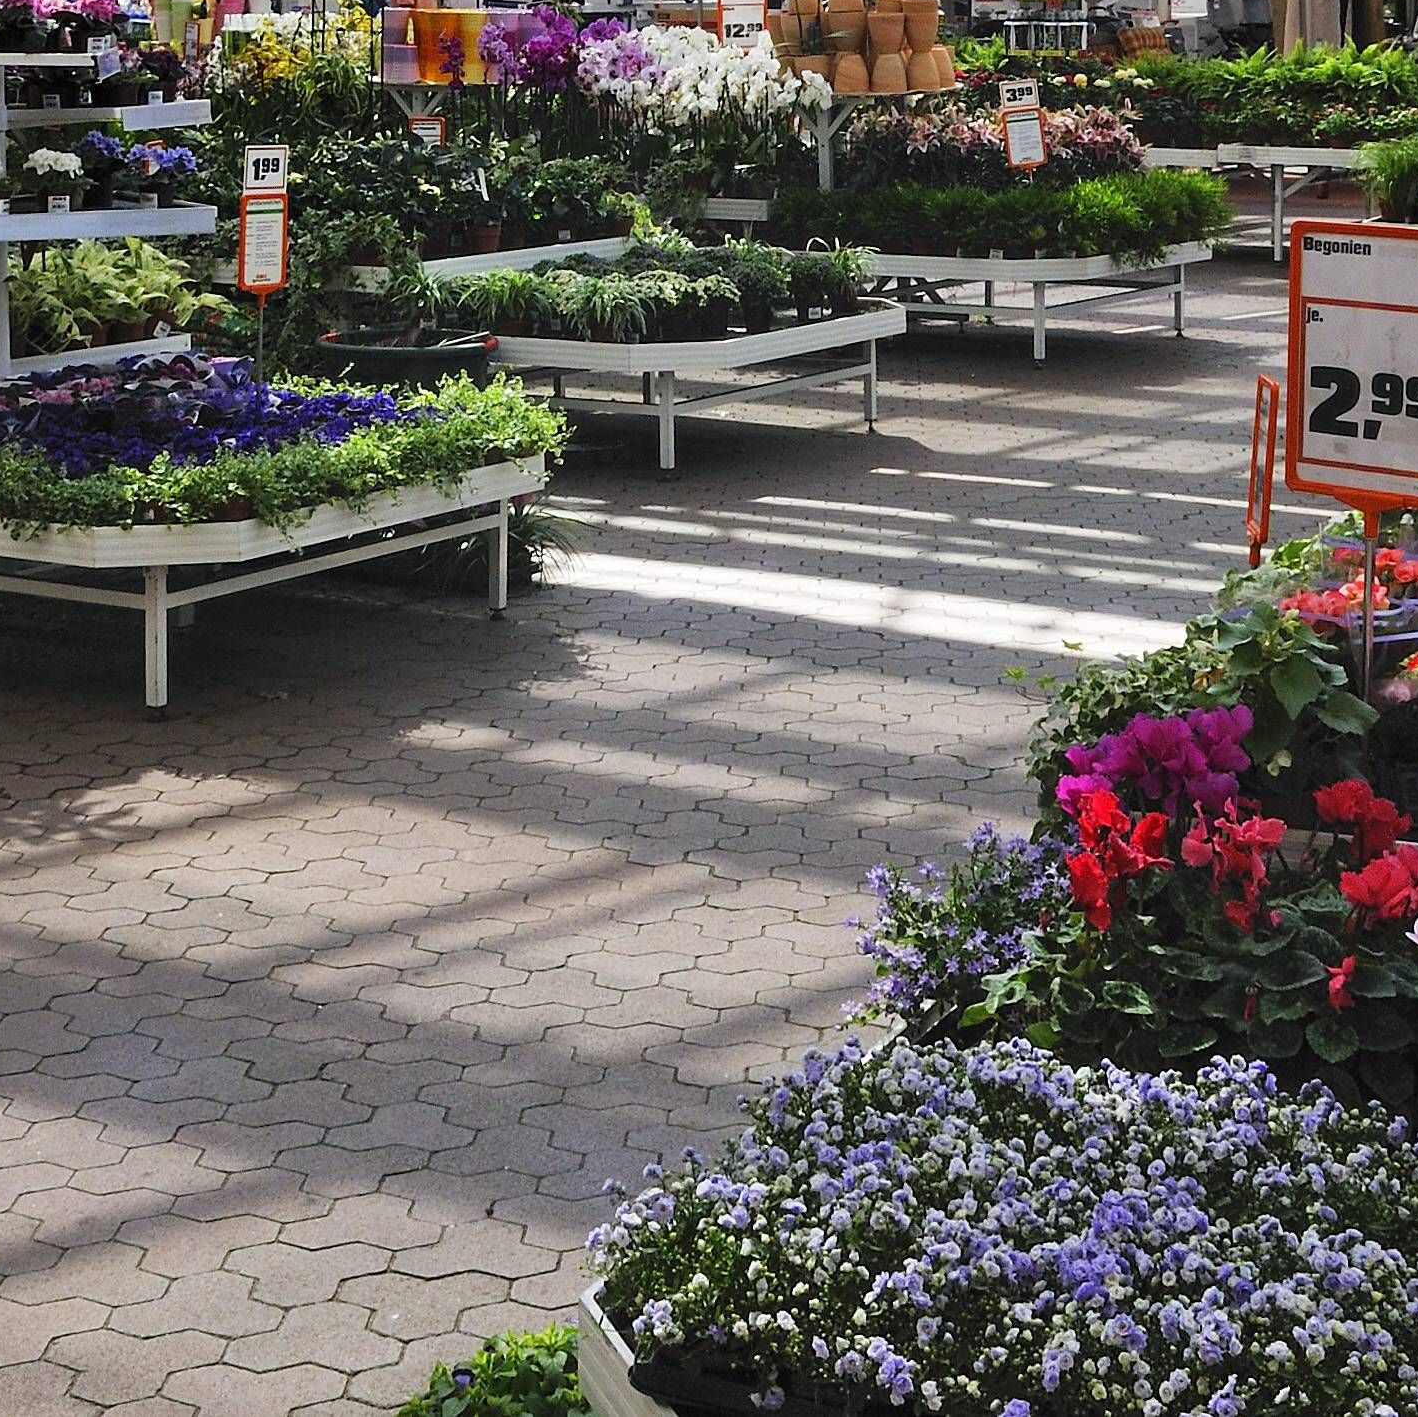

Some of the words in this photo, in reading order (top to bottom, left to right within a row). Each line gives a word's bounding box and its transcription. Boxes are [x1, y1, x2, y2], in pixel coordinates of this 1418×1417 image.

[1005, 86, 1034, 103] 3,99
[252, 157, 280, 181] 1,99
[1303, 236, 1372, 258] Begonien
[1305, 307, 1324, 324] je.
